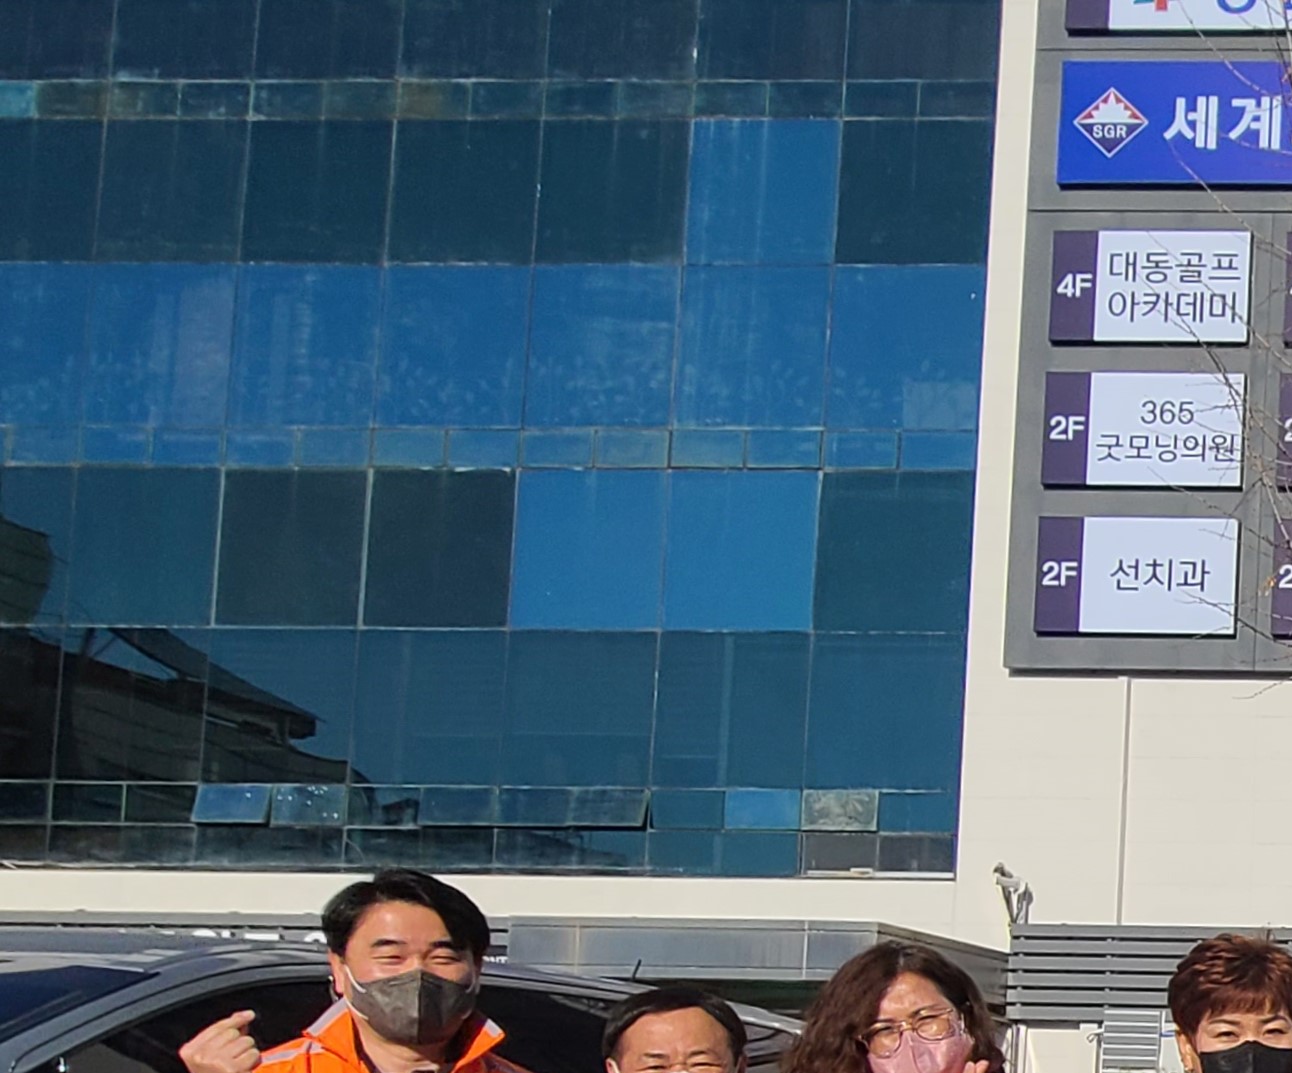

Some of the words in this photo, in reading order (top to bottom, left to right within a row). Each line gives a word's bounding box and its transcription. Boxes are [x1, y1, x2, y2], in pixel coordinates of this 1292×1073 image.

[1092, 124, 1127, 139] SGR
[1108, 251, 1242, 284] 대동골프
[1057, 273, 1092, 299] 4F
[1107, 290, 1238, 325] 아카데미
[1140, 400, 1195, 425] 365
[1050, 415, 1086, 442] 2F
[1095, 434, 1236, 464] 굿모닝의원
[1042, 562, 1078, 588] 2F
[1110, 558, 1211, 592] 선치과
